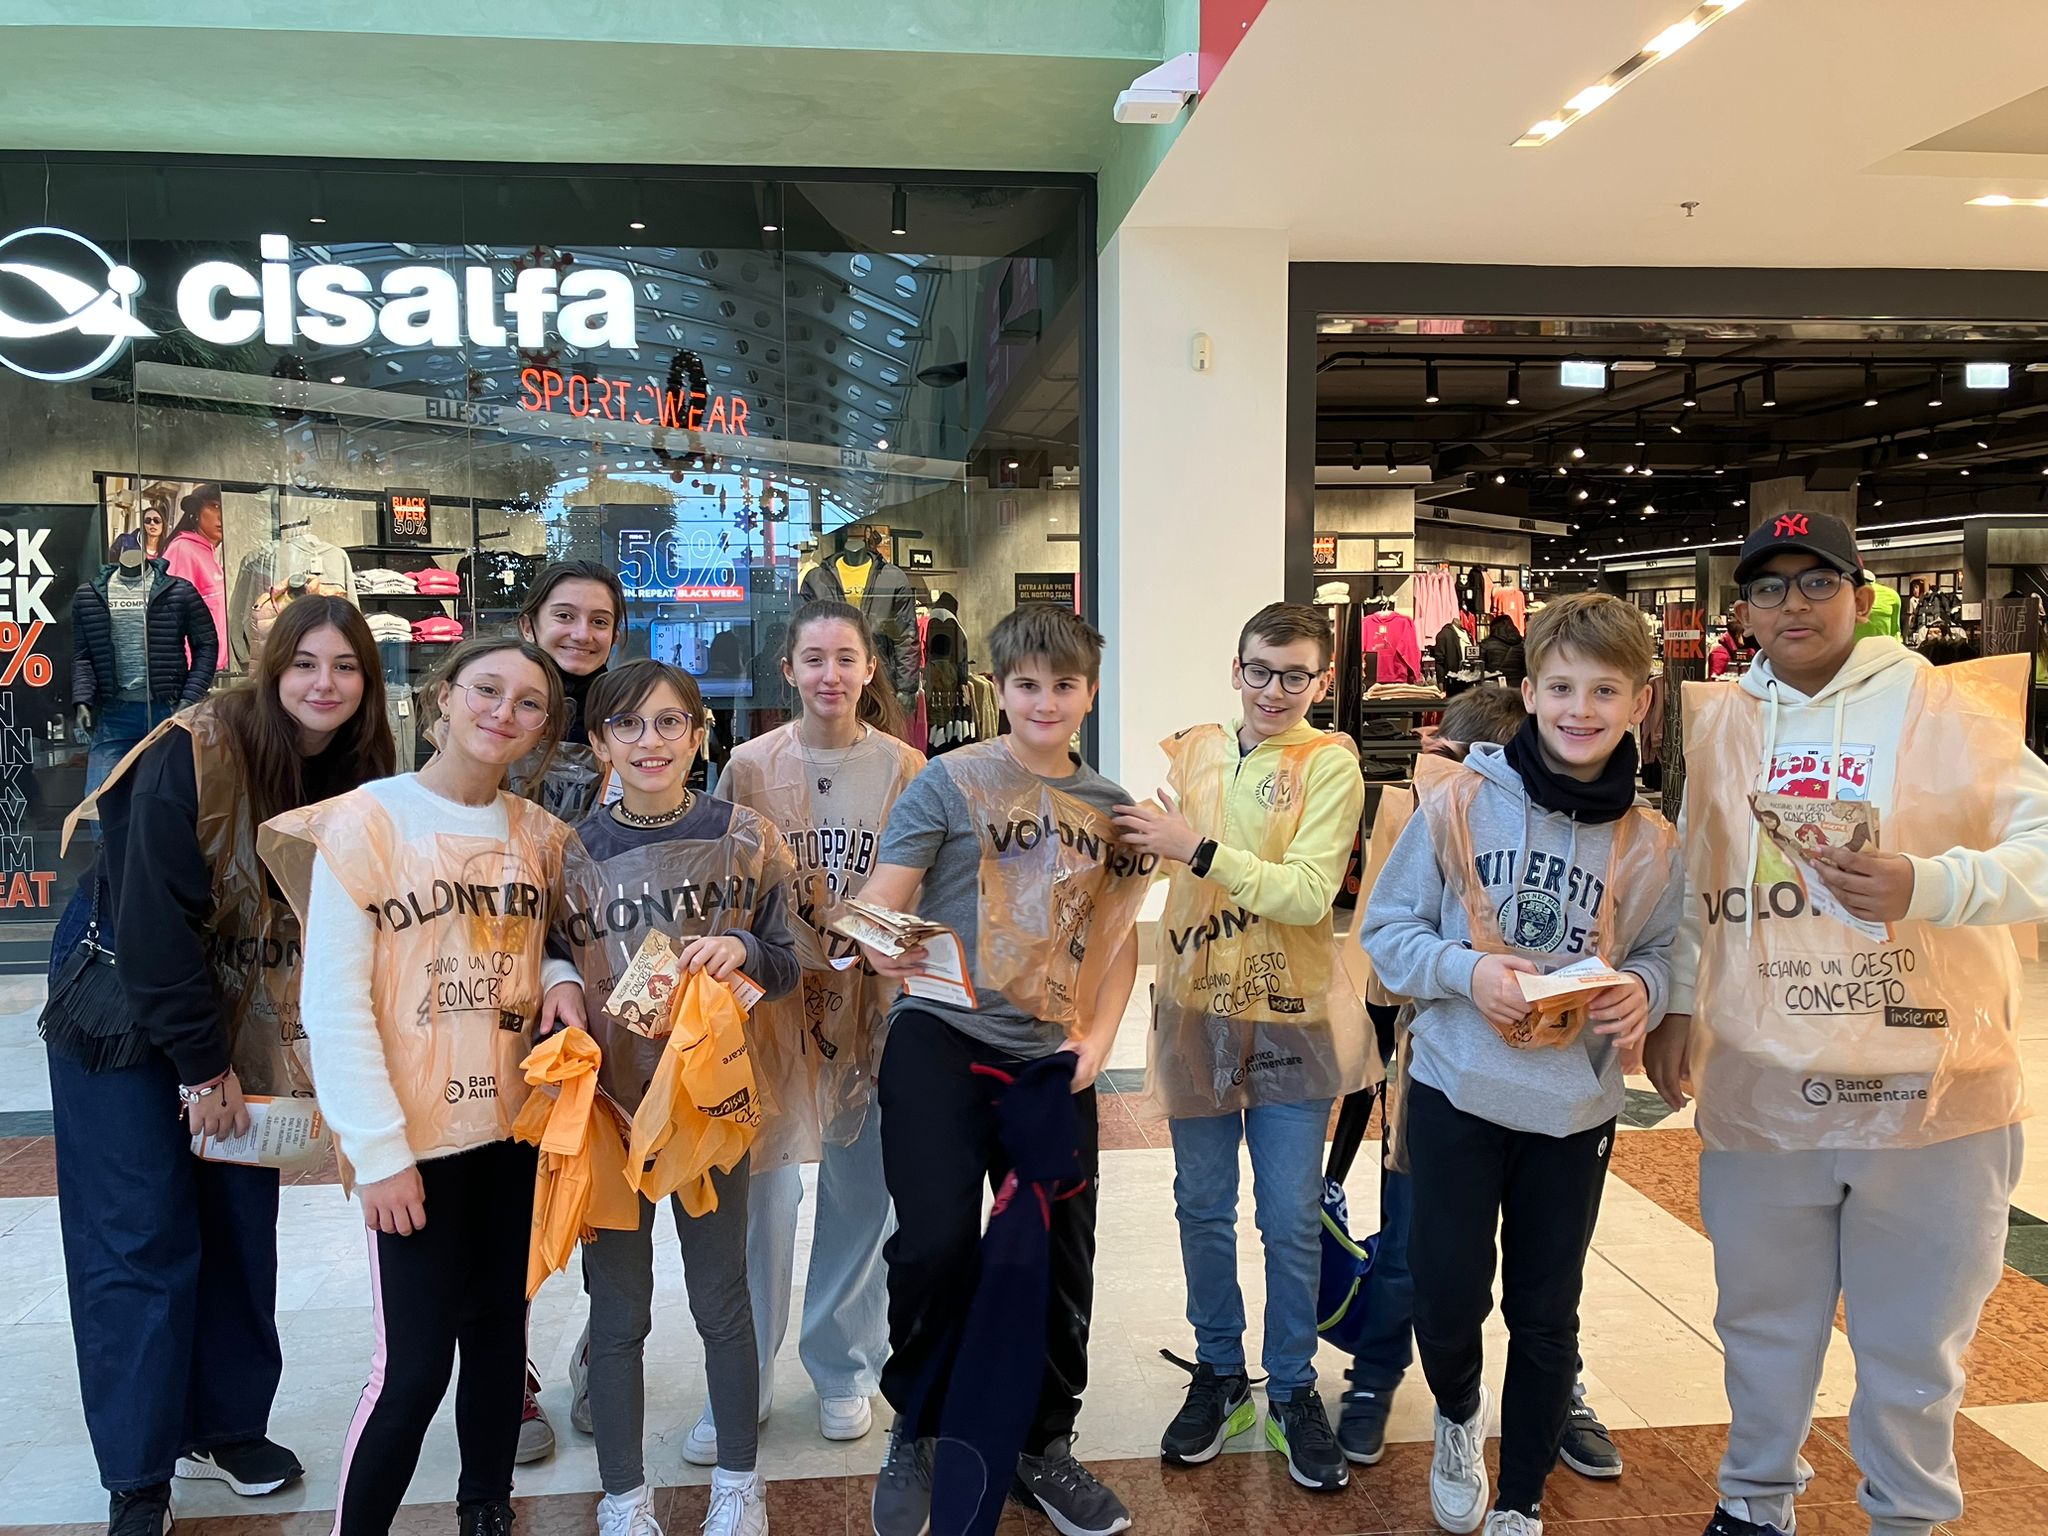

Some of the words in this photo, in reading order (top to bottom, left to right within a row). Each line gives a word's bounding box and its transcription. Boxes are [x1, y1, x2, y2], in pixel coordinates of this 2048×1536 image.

[176, 233, 638, 348] cisalfa
[426, 397, 500, 426] ELLESSE
[392, 496, 426, 507] BLACK
[394, 510, 427, 520] WEEK
[394, 519, 428, 535] 50%
[618, 529, 736, 589] 50%
[913, 554, 932, 564] FILA
[638, 588, 676, 598] REPEAT.
[677, 588, 709, 598] BLACK
[710, 588, 741, 598] WEEK.
[1018, 583, 1036, 591] ENTRA
[1805, 803, 1832, 813] GESTO
[1783, 810, 1826, 823] CONCRETO
[468, 953, 486, 972] UN
[1243, 951, 1287, 978] GESTO
[1821, 958, 1842, 976] UN
[1851, 948, 1916, 979] GESTO
[1785, 979, 1905, 1012] CONCRETO
[1835, 1078, 1884, 1092] Banco
[1836, 1088, 1928, 1104] Alimentare
